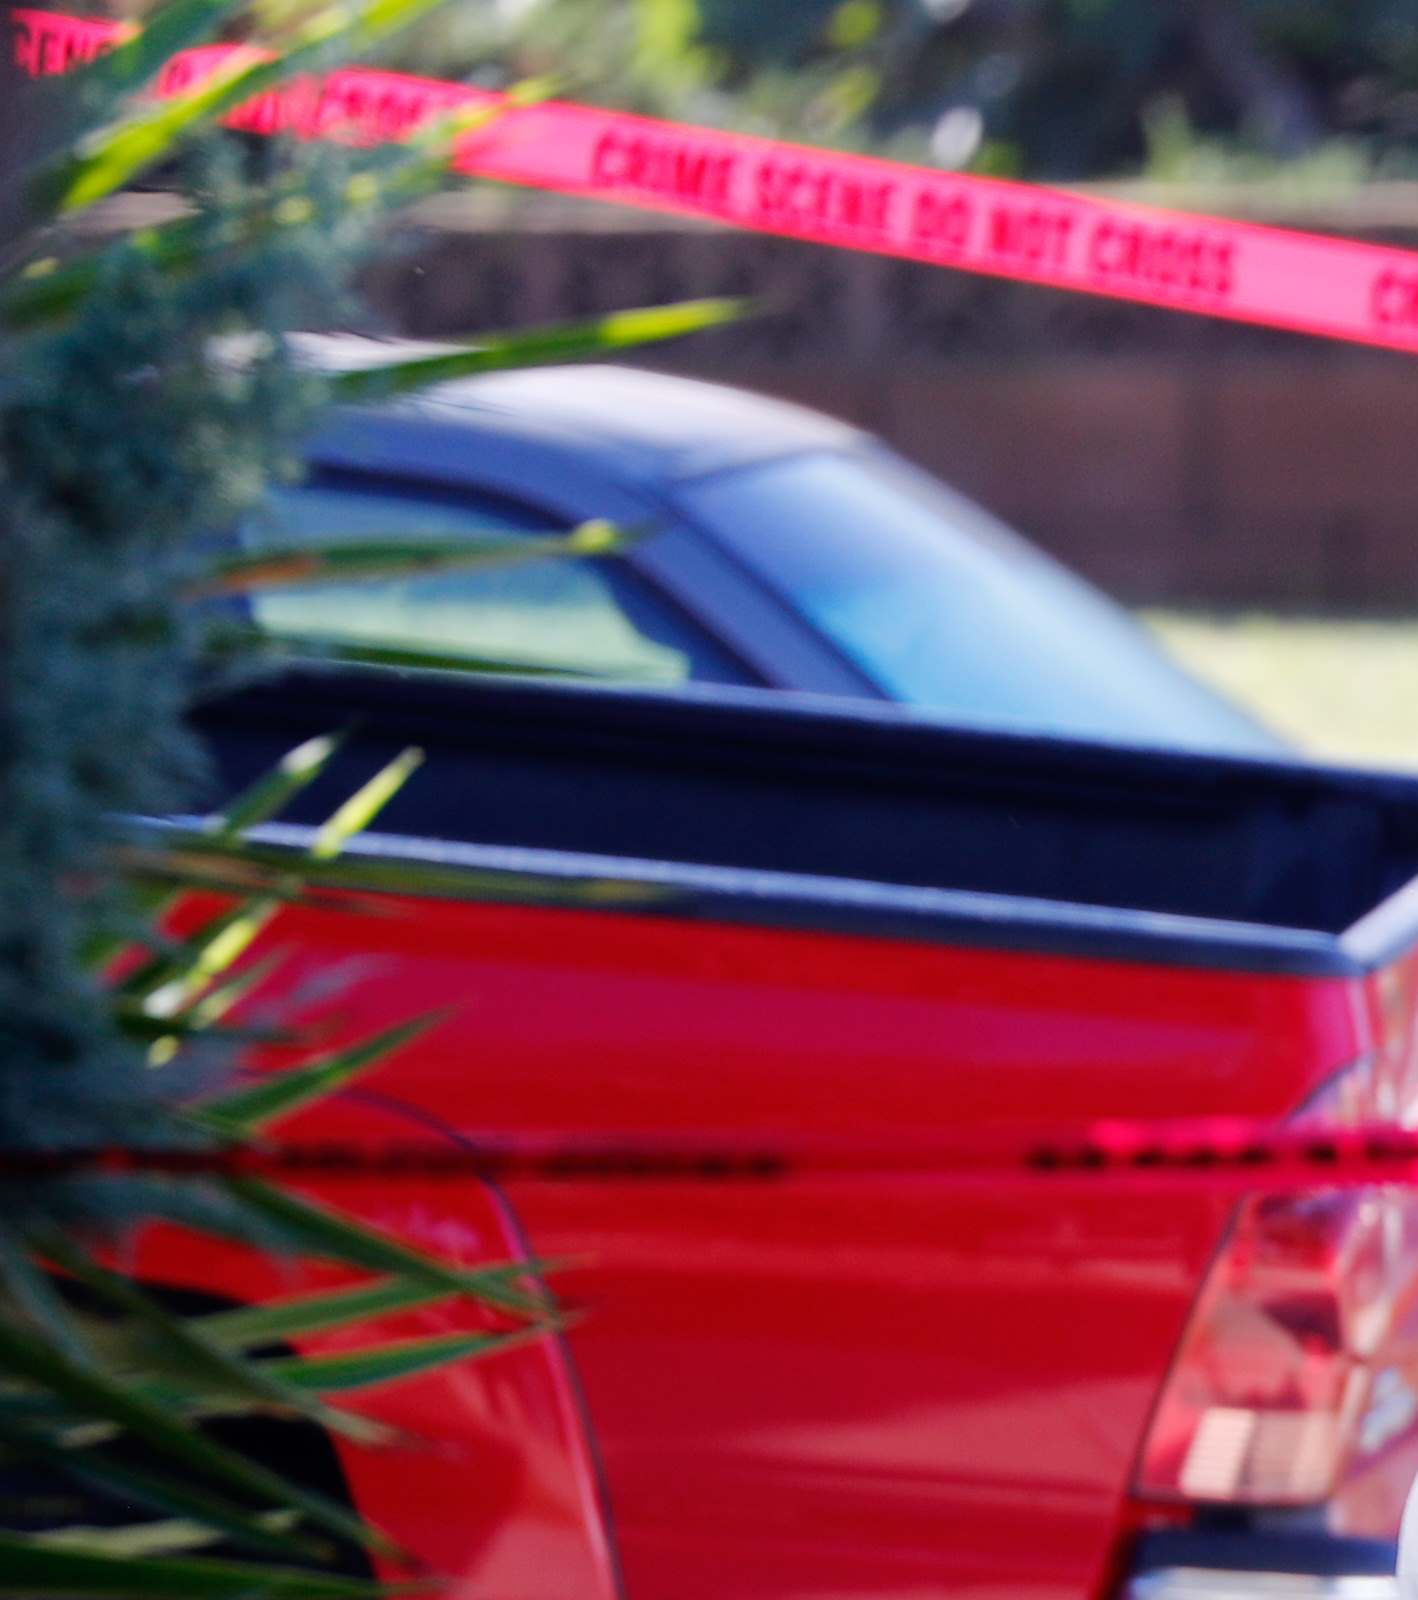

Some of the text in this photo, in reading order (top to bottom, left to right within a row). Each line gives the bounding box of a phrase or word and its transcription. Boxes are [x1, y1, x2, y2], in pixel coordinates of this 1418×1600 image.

[591, 130, 1234, 297] CRIME SCENE DO NOT CROSS
